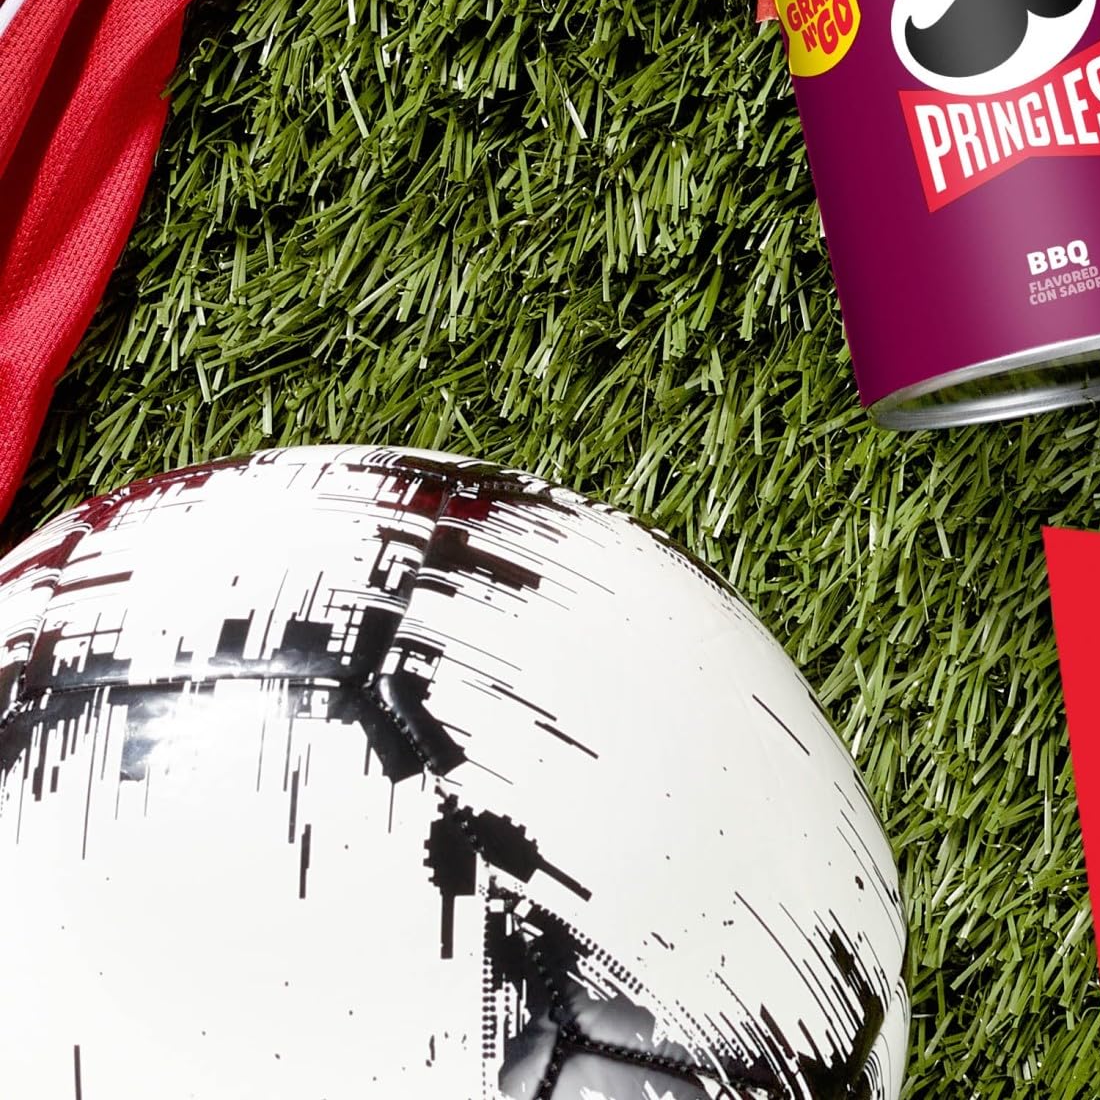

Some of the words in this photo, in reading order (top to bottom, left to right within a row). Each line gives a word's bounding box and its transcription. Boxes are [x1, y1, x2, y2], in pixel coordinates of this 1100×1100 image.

[1026, 239, 1091, 275] BBQ
[1028, 265, 1099, 294] FLAVORED
[1029, 289, 1058, 306] CON
